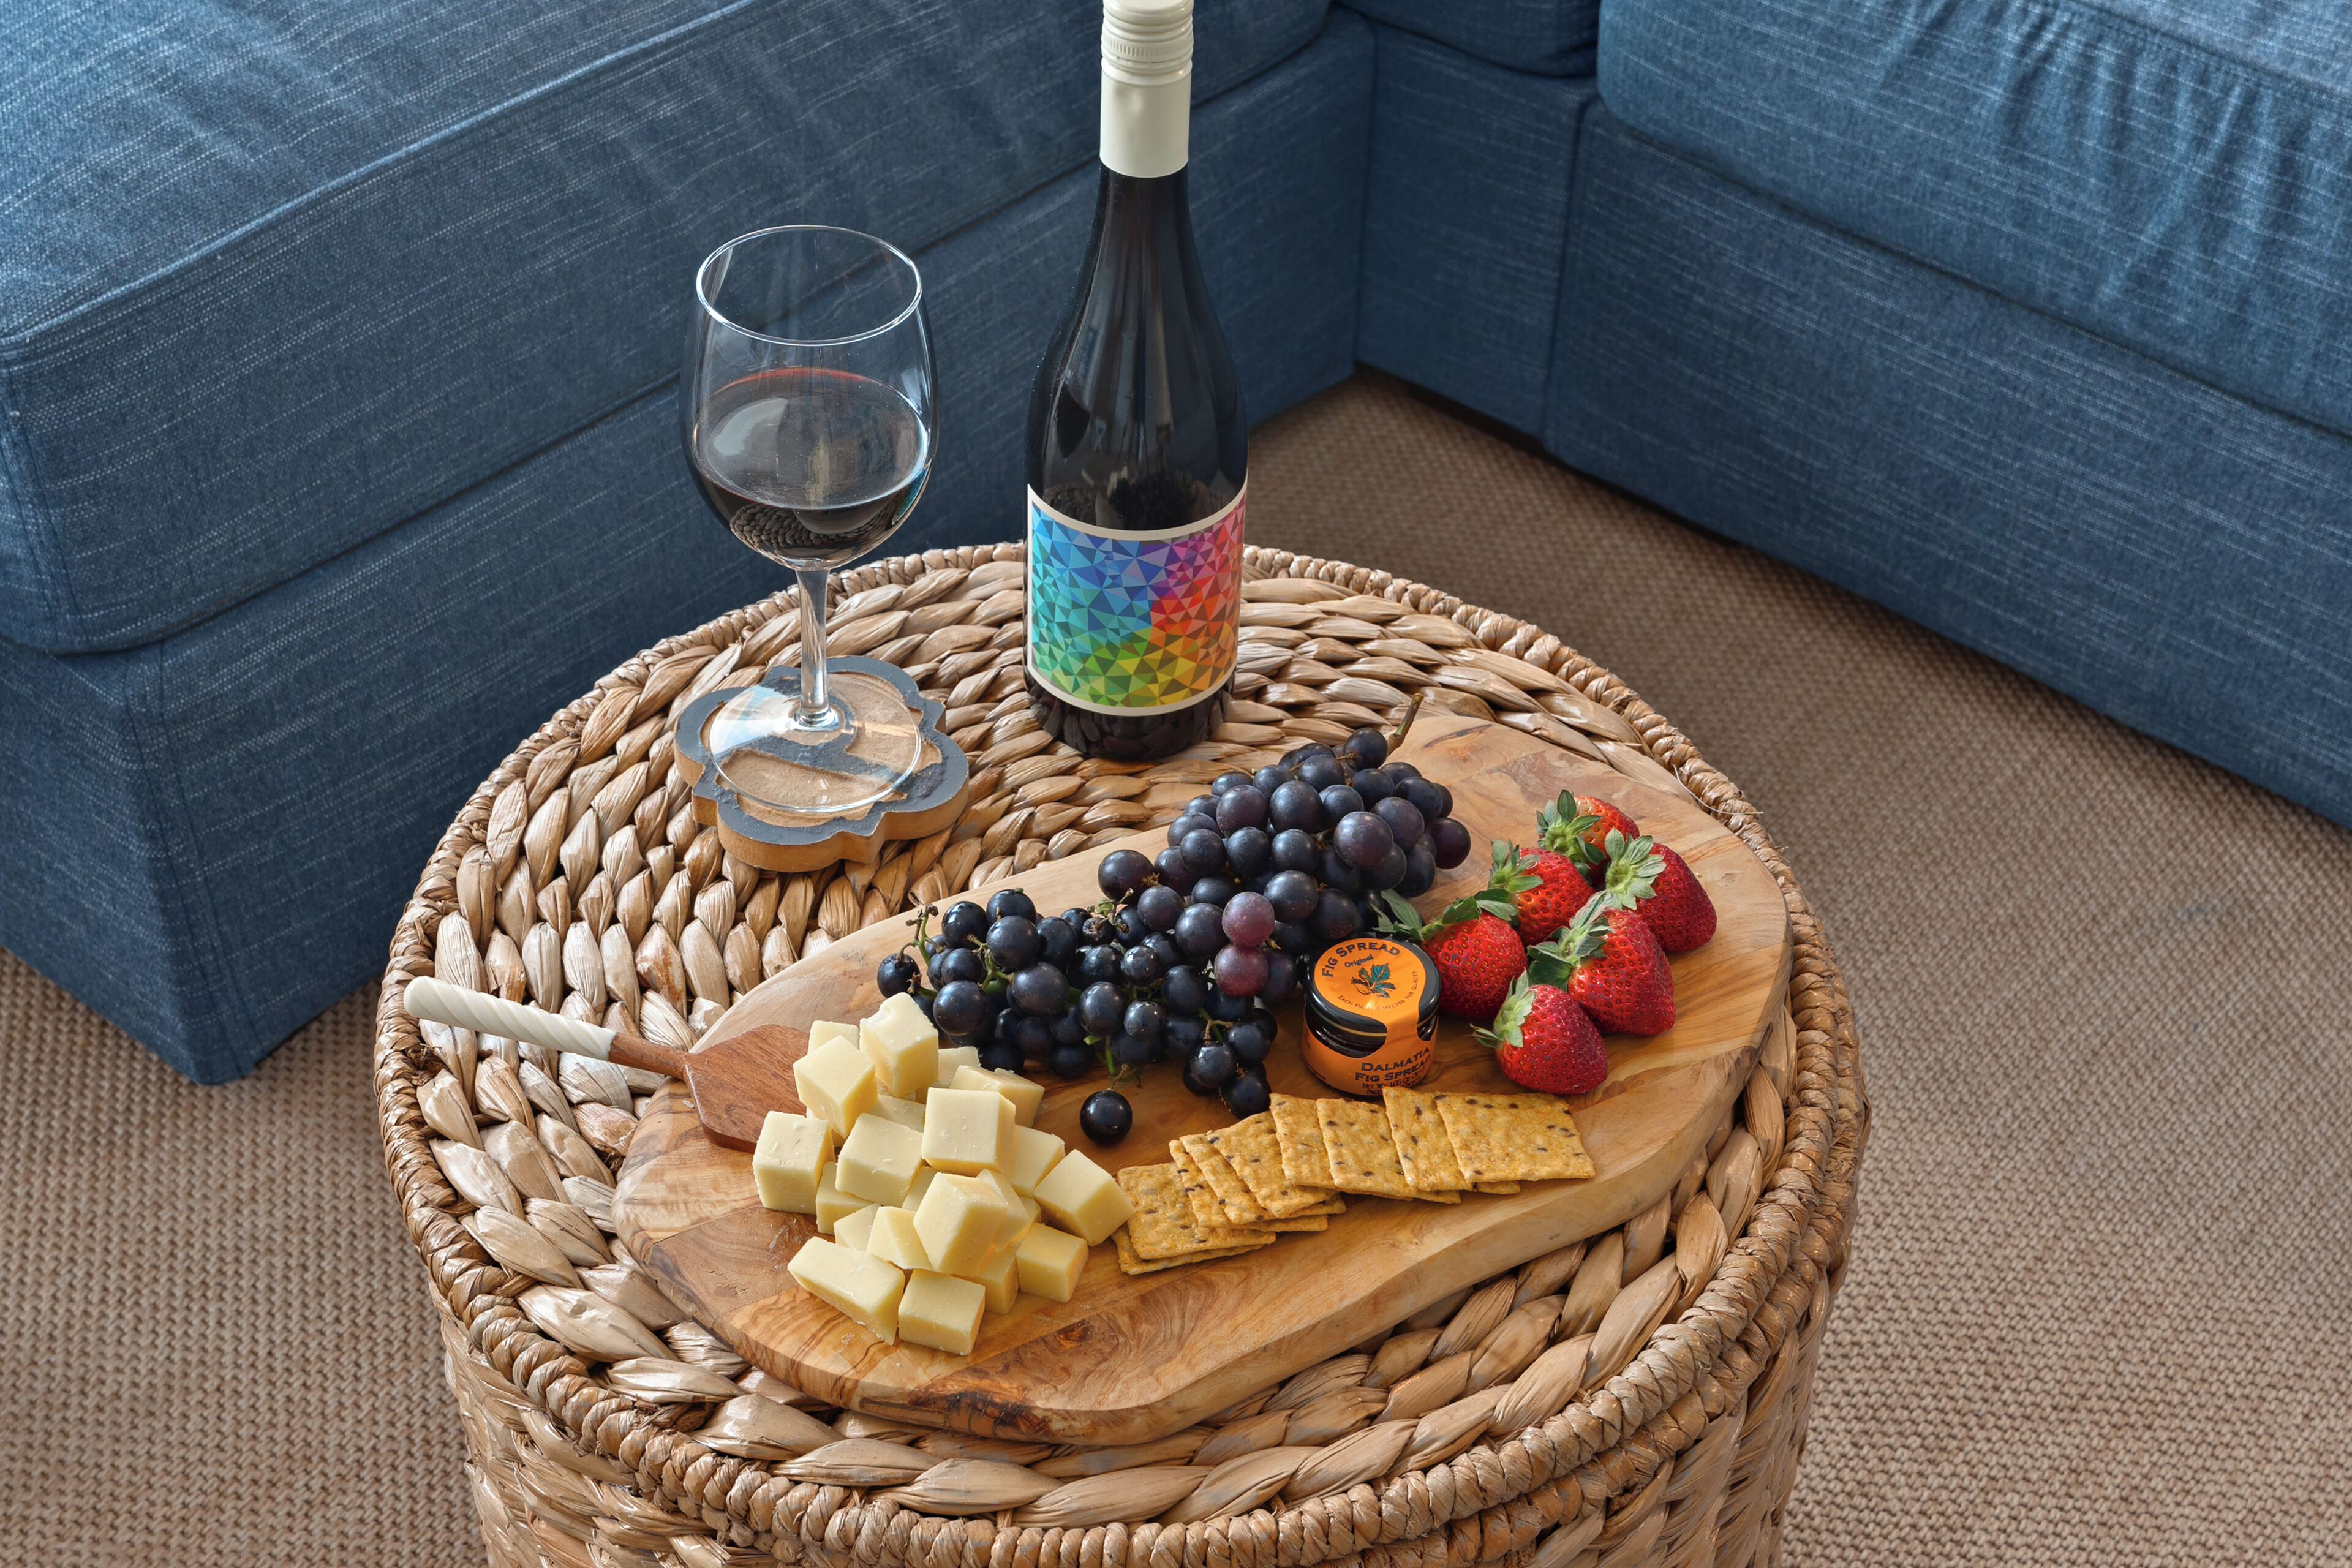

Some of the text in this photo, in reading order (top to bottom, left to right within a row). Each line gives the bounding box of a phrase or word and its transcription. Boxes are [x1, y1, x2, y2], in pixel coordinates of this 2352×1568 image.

[1322, 942, 1400, 977] FIG SPREAD
[1344, 954, 1373, 968] Original
[1338, 995, 1353, 1005] EACH
[1355, 1072, 1380, 1082] FIG
[1384, 1054, 1431, 1081] SPREAD
[1361, 1047, 1430, 1072] DALMATIA
